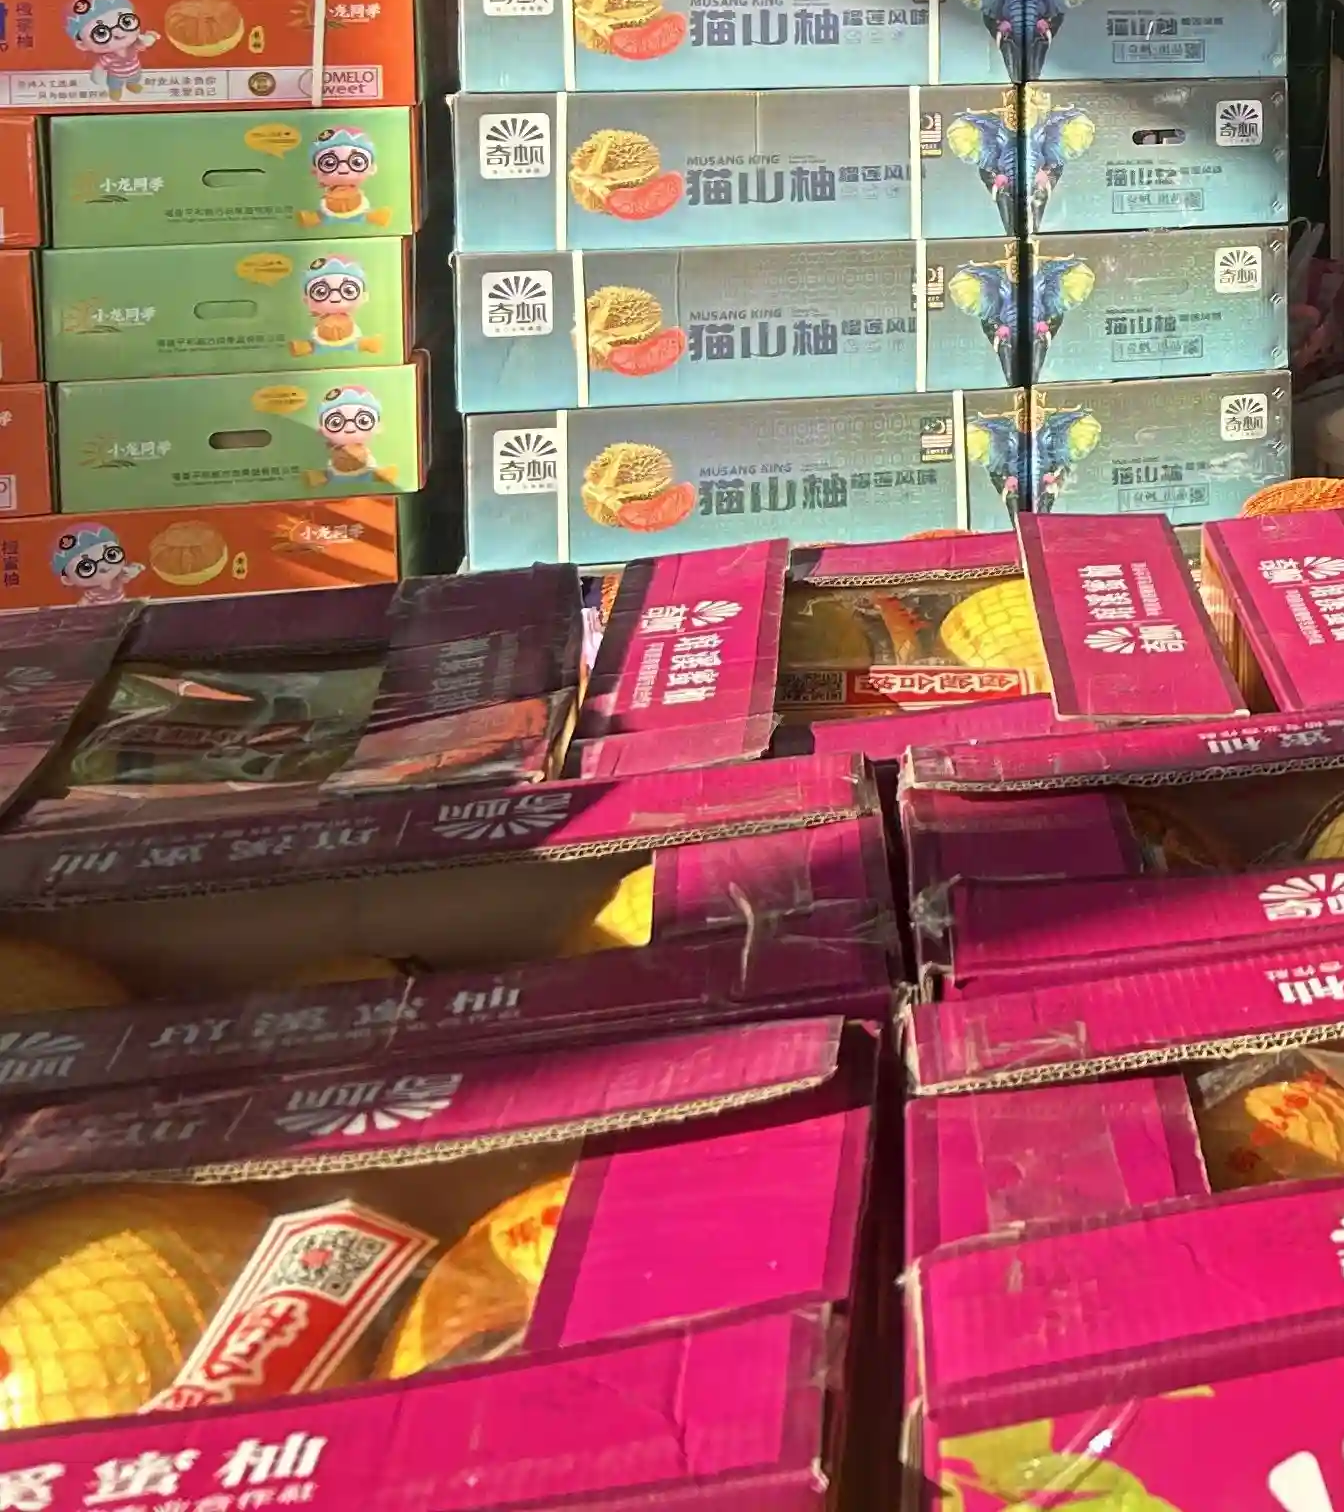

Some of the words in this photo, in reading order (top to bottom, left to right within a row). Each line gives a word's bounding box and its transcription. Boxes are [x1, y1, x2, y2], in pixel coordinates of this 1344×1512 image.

[689, 9, 840, 47] 猫山柚
[322, 70, 374, 84] OMELO
[687, 155, 744, 166] MUSANG
[748, 154, 781, 164] KING
[100, 177, 165, 193] 小龙同学
[687, 167, 836, 206] 猫山柚
[92, 306, 157, 323] 小龙同学
[690, 309, 747, 320] MUSANG
[750, 308, 783, 319] KING
[689, 320, 838, 361] 猫山柚
[107, 441, 172, 458] 小龙同学
[700, 465, 759, 476] MUSANG
[762, 463, 793, 474] KING
[699, 475, 848, 516] 猫山柚
[301, 524, 365, 542] 小龙同学
